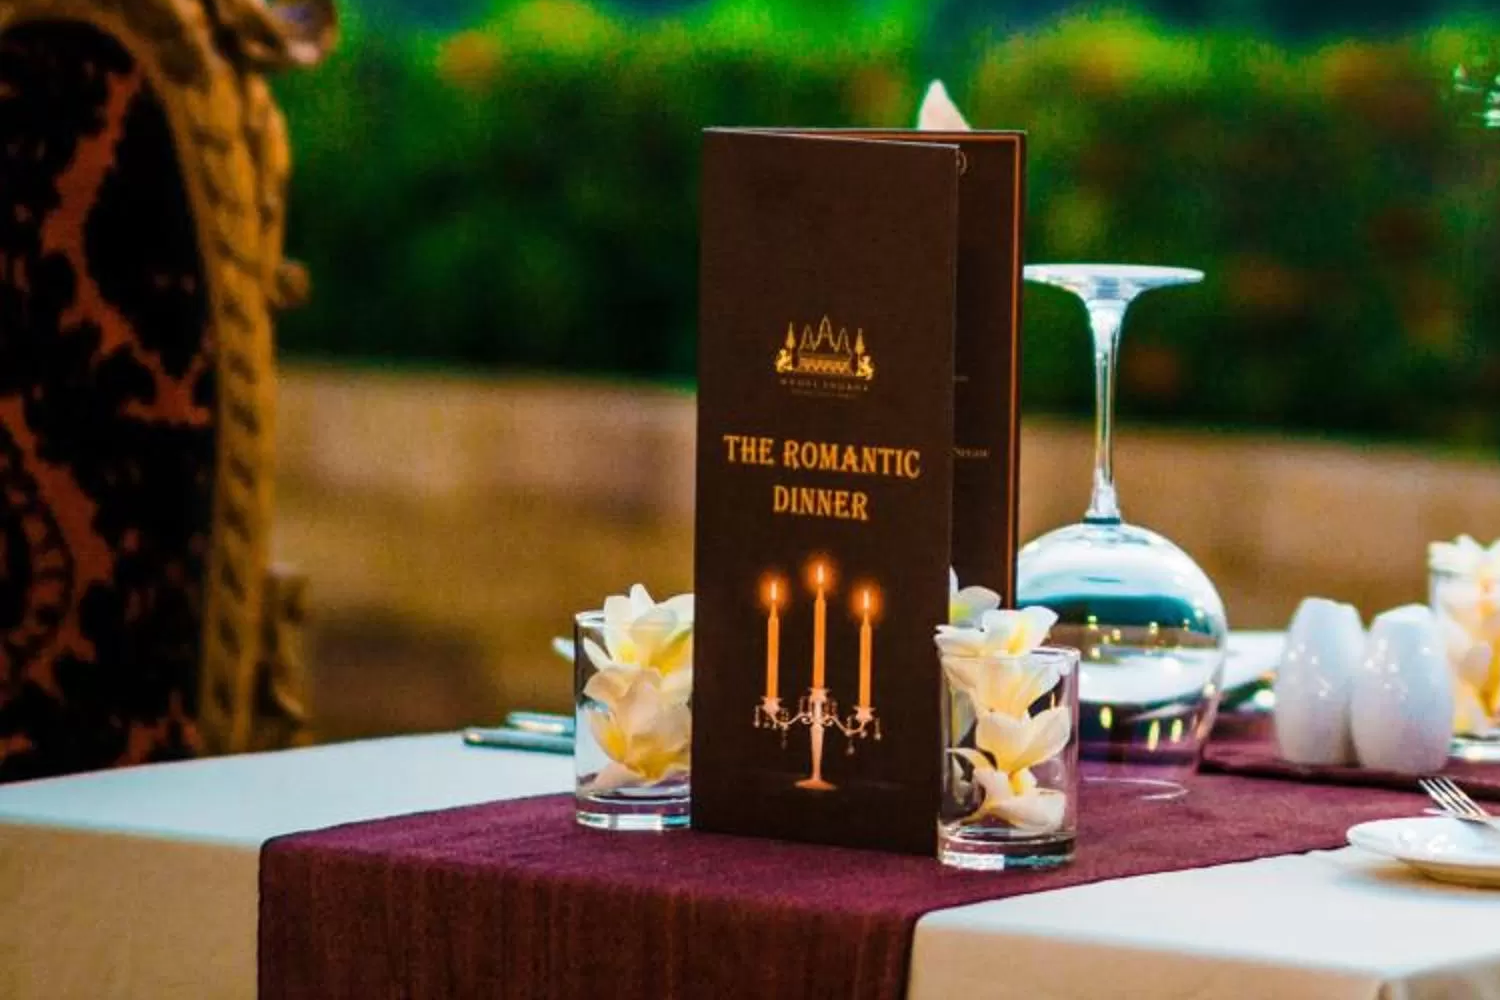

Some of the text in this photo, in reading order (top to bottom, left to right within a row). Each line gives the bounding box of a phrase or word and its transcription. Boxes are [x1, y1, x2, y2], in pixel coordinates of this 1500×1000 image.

[723, 435, 921, 479] THE ROMANTIC
[773, 485, 869, 521] DINNER
